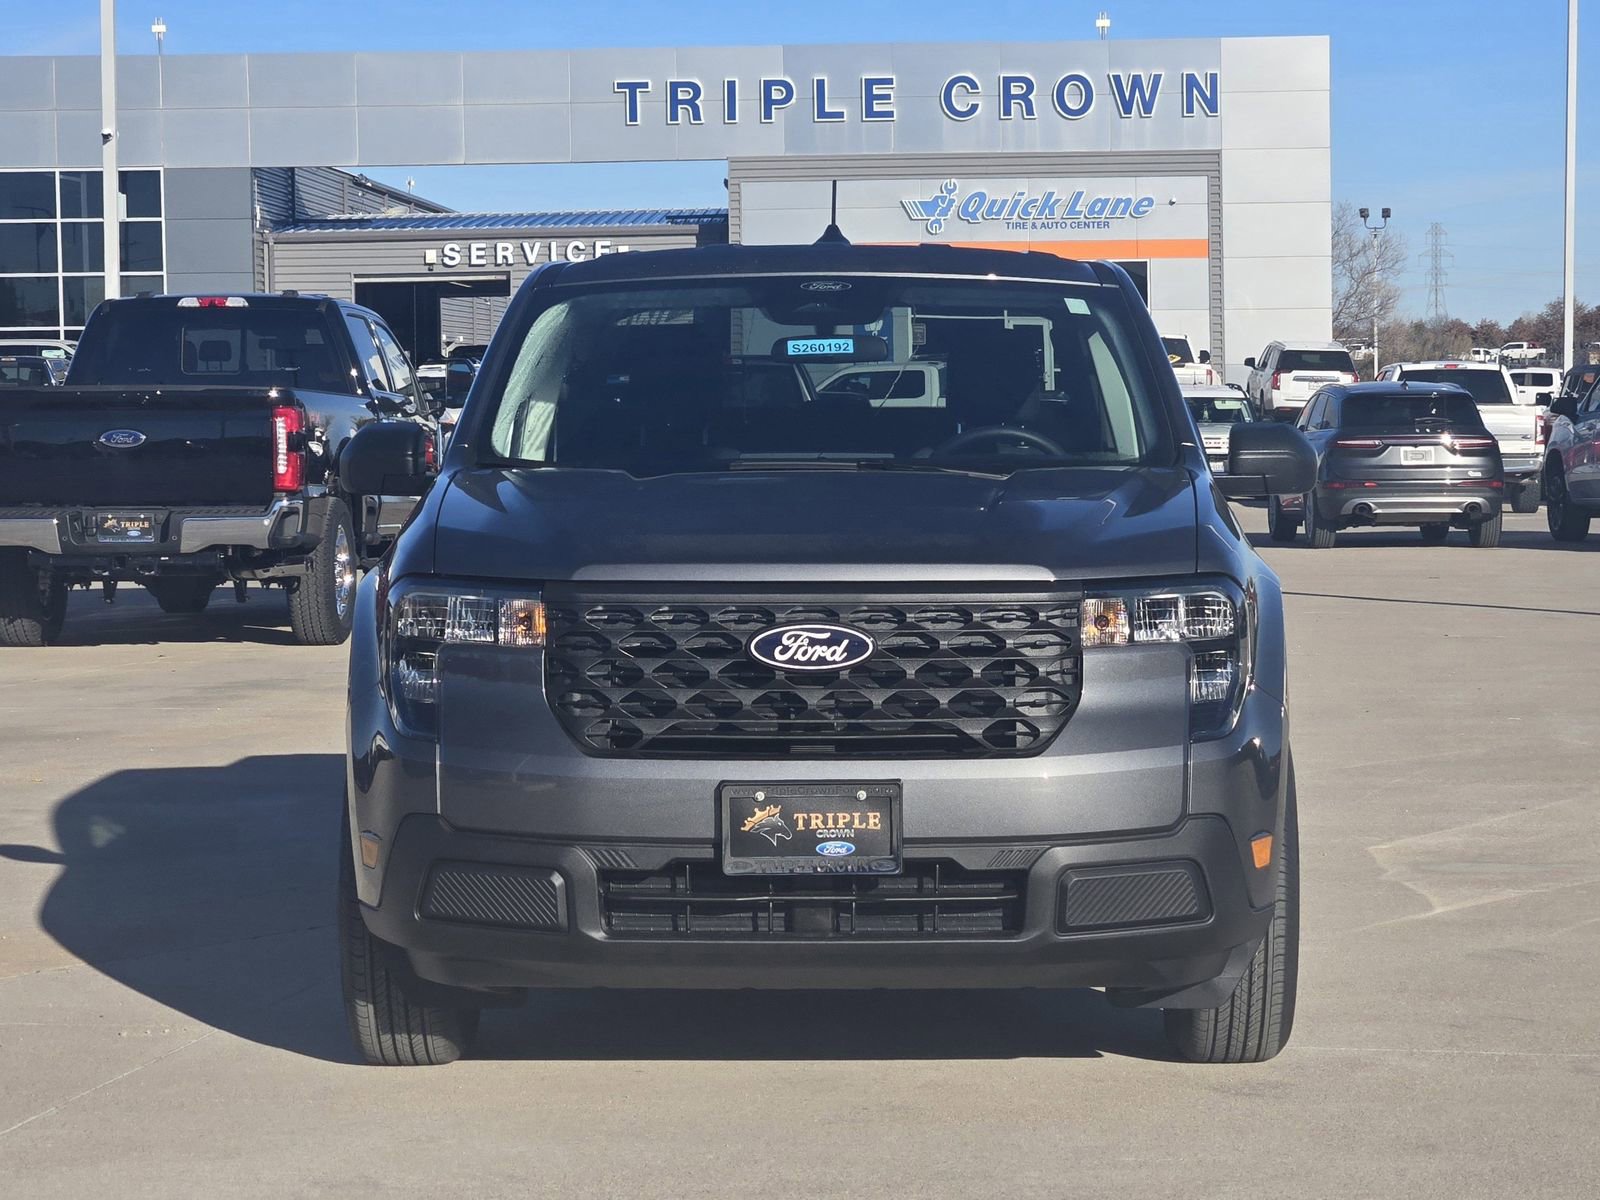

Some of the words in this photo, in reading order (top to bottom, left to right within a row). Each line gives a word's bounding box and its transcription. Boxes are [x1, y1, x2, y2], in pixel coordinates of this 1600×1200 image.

[613, 75, 897, 125] TRIPLE
[941, 70, 1221, 121] CROWN
[958, 190, 1063, 223] Quick
[1062, 190, 1156, 219] Lane
[1005, 221, 1029, 230] TIRE
[1030, 221, 1038, 230] &
[1040, 221, 1068, 230] AUTO
[1070, 220, 1110, 230] CENTER
[442, 240, 612, 266] SERVICE
[792, 342, 850, 353] S260192
[774, 631, 849, 661] Ford
[793, 812, 881, 831] TRIPLE
[816, 828, 855, 838] CROWN
